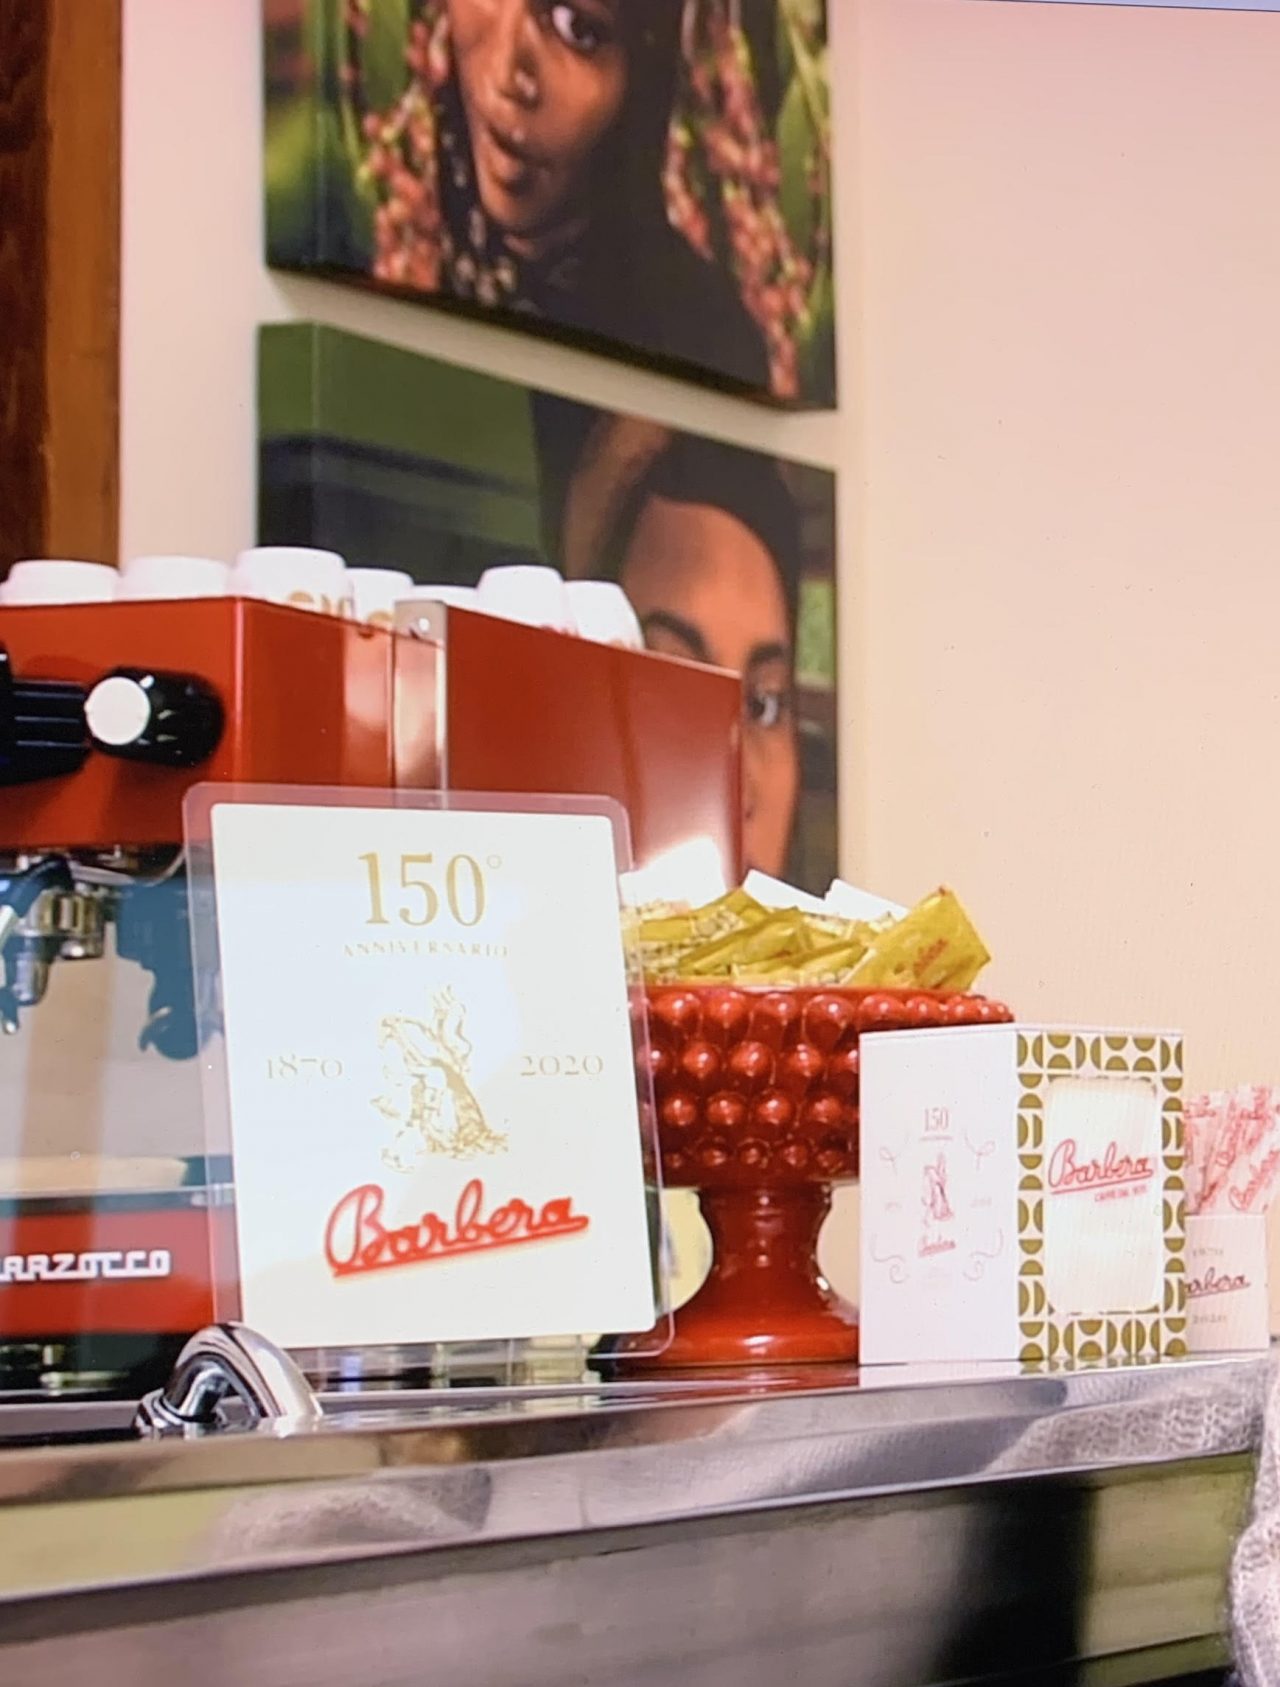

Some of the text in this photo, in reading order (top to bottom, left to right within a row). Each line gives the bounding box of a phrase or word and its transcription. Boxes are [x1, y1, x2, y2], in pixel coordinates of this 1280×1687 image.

[519, 1054, 605, 1077] 2020
[923, 1107, 950, 1132] 150
[1047, 1138, 1155, 1196] Barbera
[323, 1178, 590, 1278] Barbera
[0, 1249, 171, 1281] ARZOCCO
